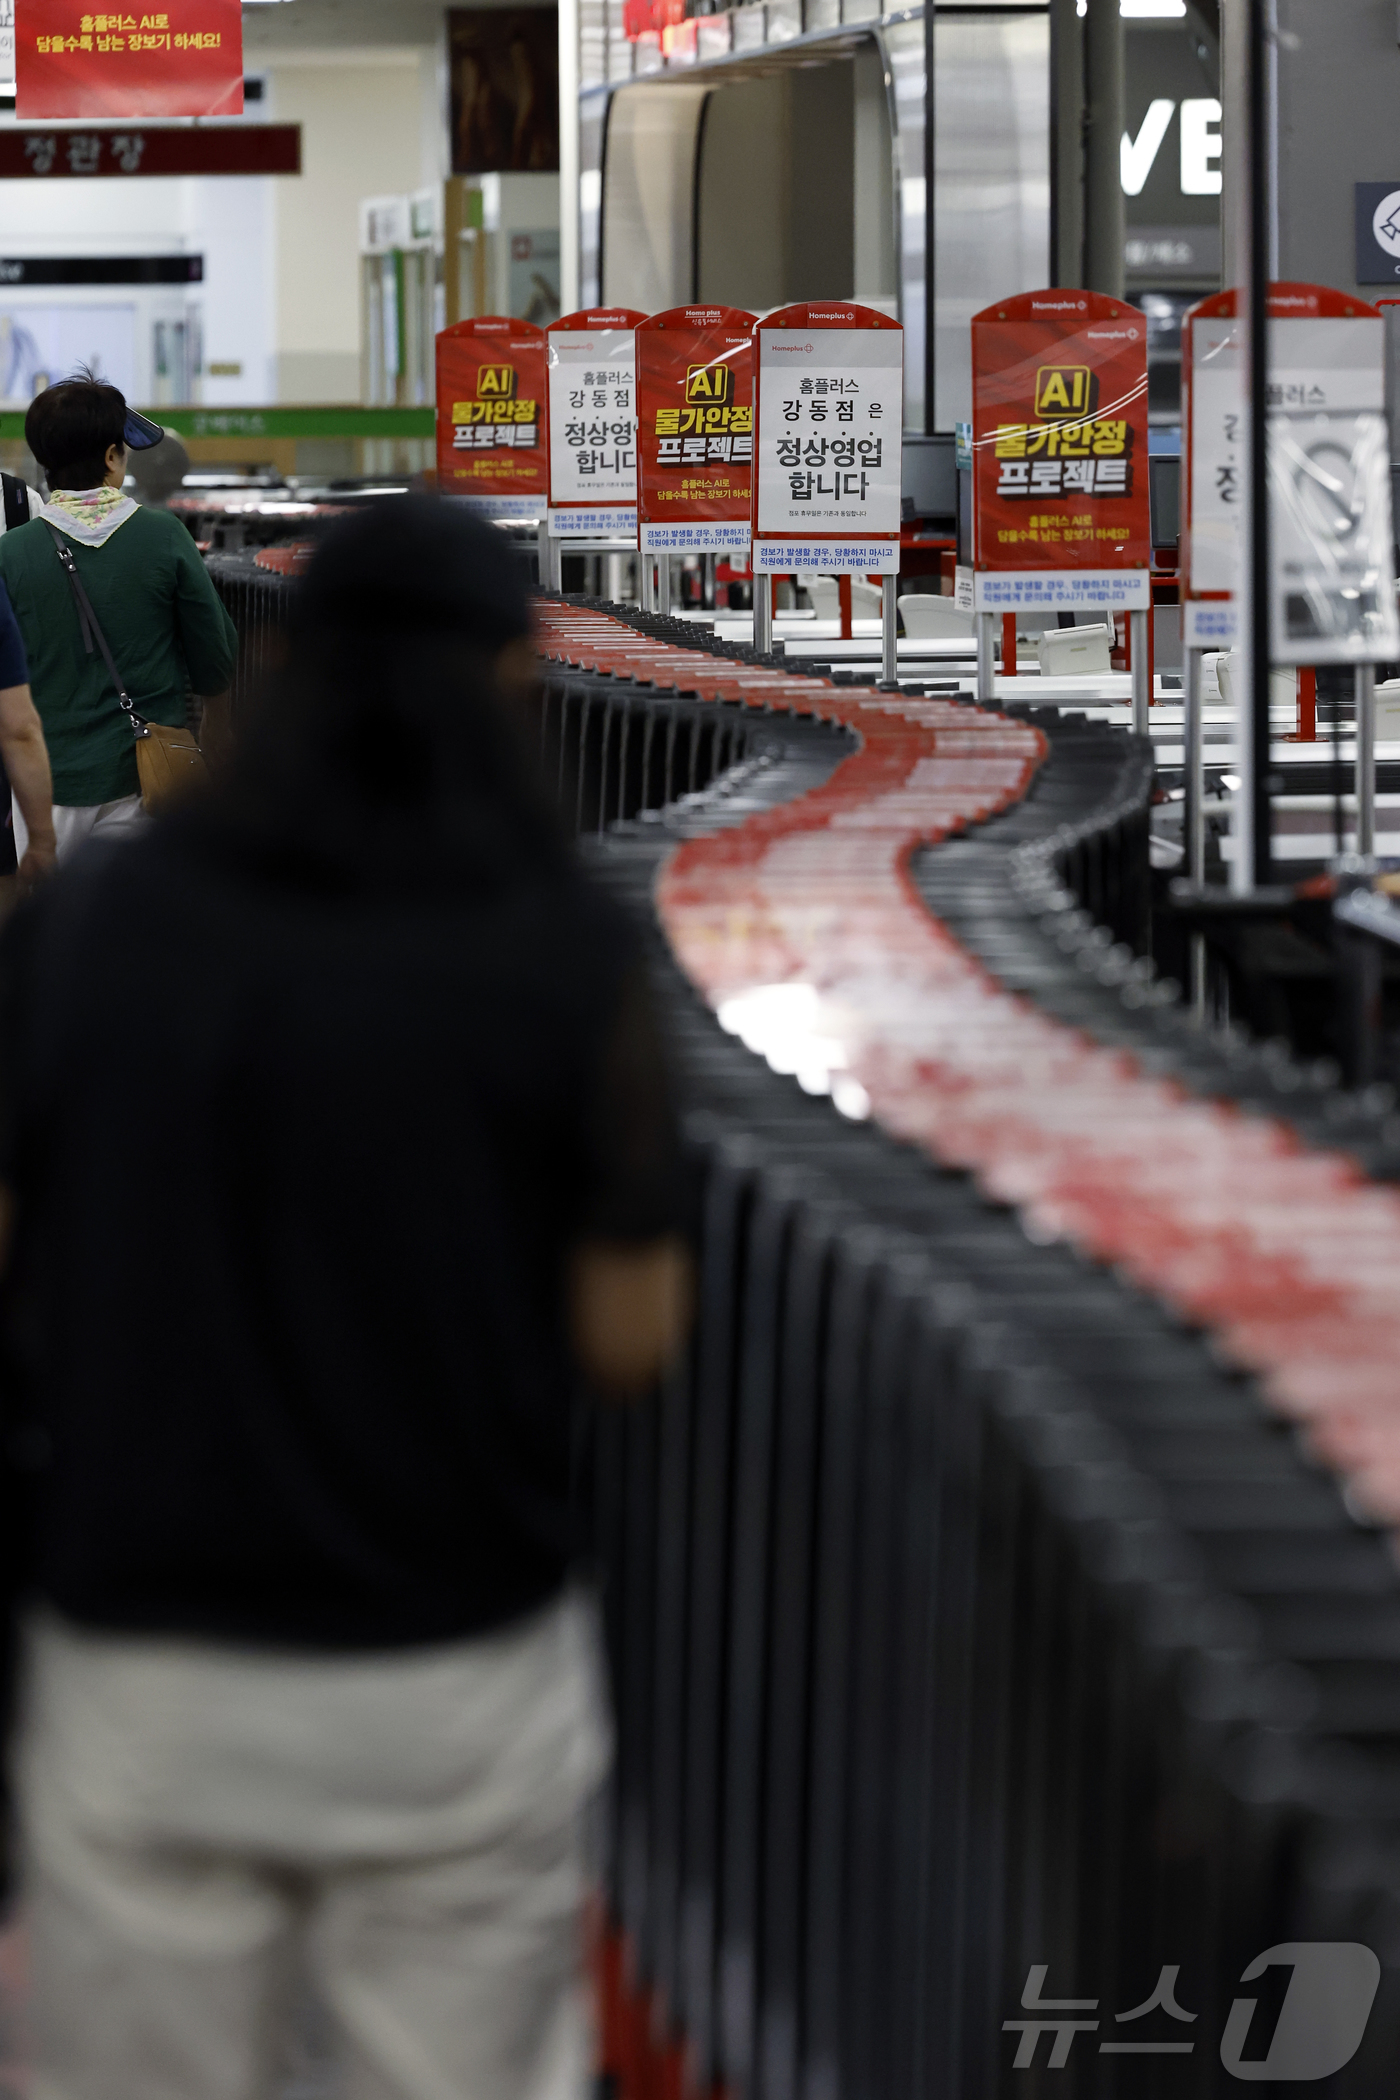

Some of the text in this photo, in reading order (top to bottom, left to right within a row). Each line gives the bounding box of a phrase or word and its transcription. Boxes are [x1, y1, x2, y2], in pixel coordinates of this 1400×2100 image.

[80, 14, 170, 33] 홈플러스 AI로
[36, 32, 221, 53] 담을수록 남는 장보기 하세요!
[808, 312, 846, 320] Homeplus
[1032, 301, 1076, 311] Homeplus
[480, 369, 509, 392] AI
[583, 371, 634, 386] 홈플러스
[689, 368, 723, 396] AI
[799, 378, 860, 395] 홈플러스
[569, 389, 629, 408] 강동점
[1039, 372, 1083, 408] AI
[655, 406, 752, 435] 물가안정
[782, 400, 883, 421] 강동점 은
[452, 424, 537, 448] 프로젝트
[565, 421, 636, 446] 정상영
[995, 420, 1127, 458] 물가안정
[656, 436, 752, 463] 프로젝트
[776, 437, 882, 468] 정상영업
[681, 479, 730, 490] 홈플러스 AI로
[788, 471, 870, 501] 합니다
[996, 459, 1127, 495] 프로젝트
[657, 490, 689, 500] 담을수록
[690, 490, 706, 500] 남는
[707, 489, 731, 499] 장보기
[647, 530, 669, 538] 경보가
[671, 529, 693, 537] 발생할
[695, 529, 713, 537] 경우,
[715, 528, 744, 537] 당황하지
[678, 538, 700, 546] 문의해
[727, 537, 751, 545] 바랍니
[760, 548, 893, 557] 경보가 발생할 경우, 당황하지 마시고
[760, 558, 879, 566] 직원에게 문의해 주시기 바랍니다
